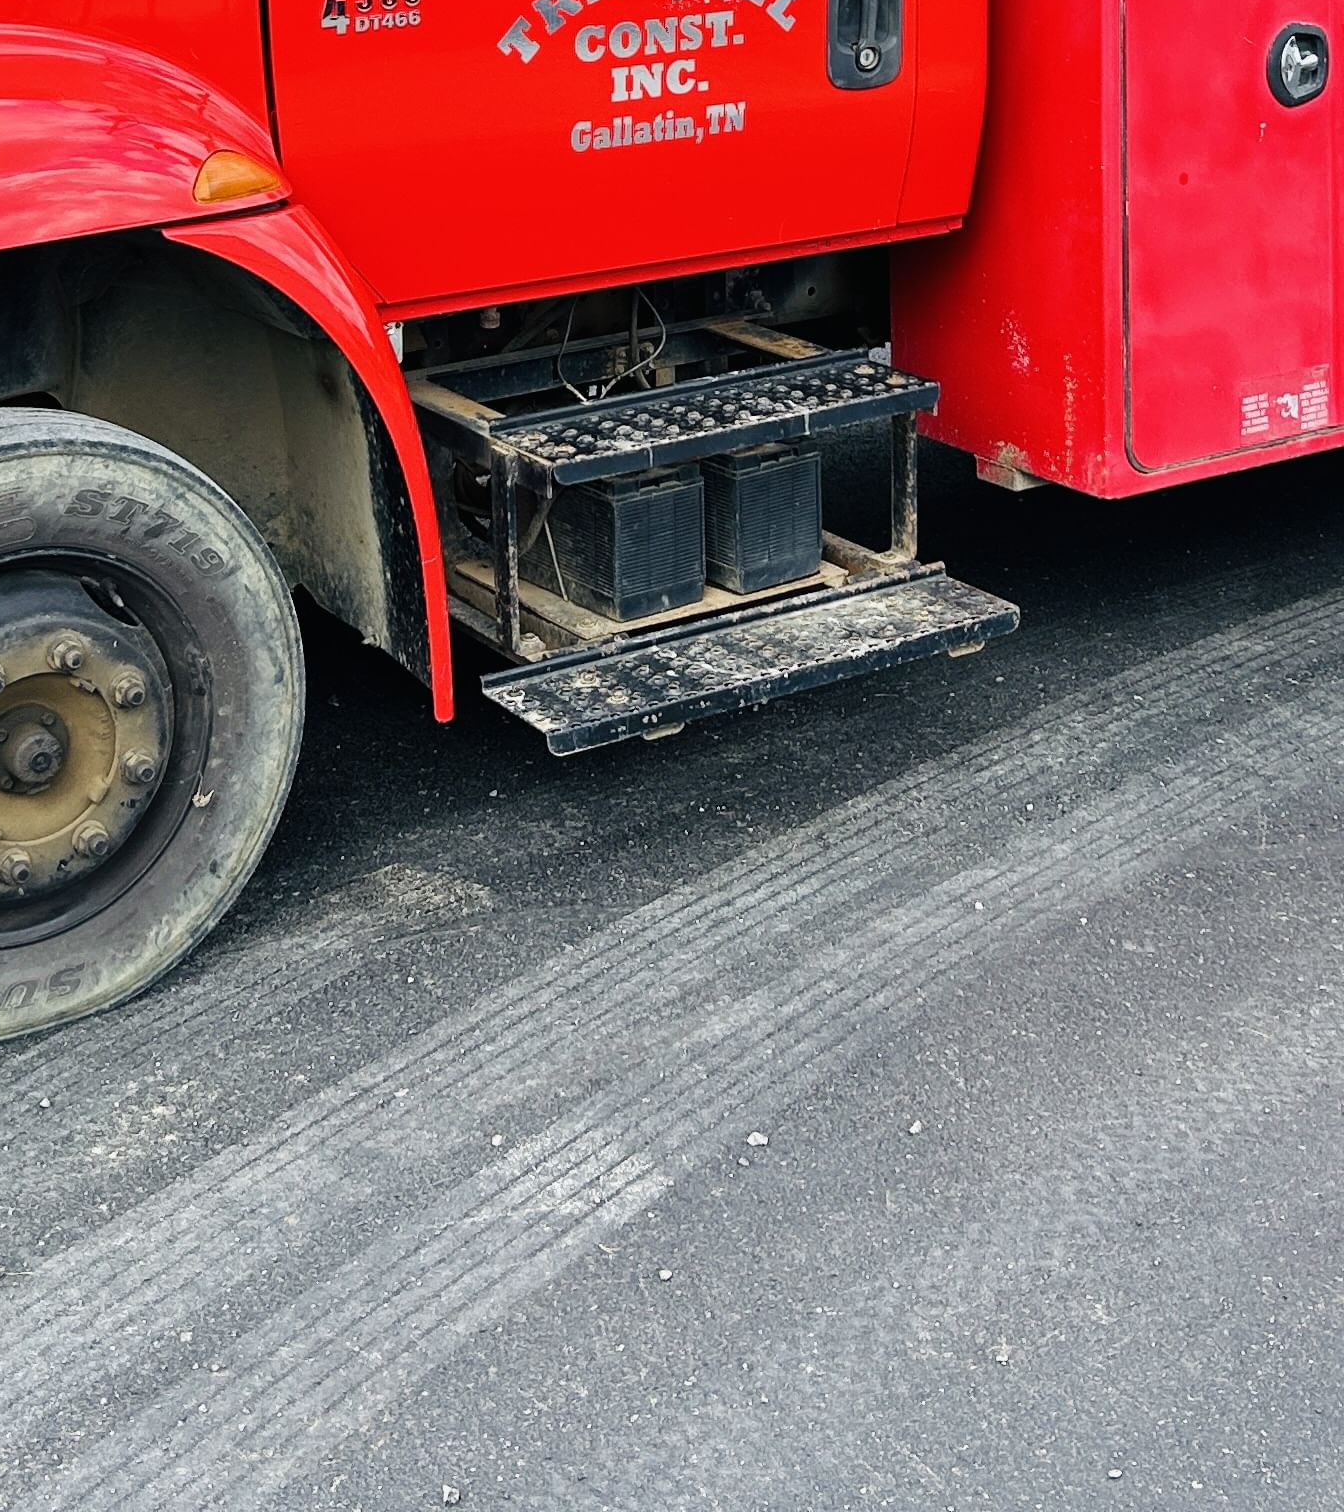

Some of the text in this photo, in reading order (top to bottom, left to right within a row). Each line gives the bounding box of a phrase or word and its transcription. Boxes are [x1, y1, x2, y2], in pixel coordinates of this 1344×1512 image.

[354, 8, 422, 33] DT466
[574, 10, 745, 63] CONST.
[610, 59, 709, 103] INC.
[570, 101, 747, 153] Gallatin, TN
[63, 488, 226, 577] ST719
